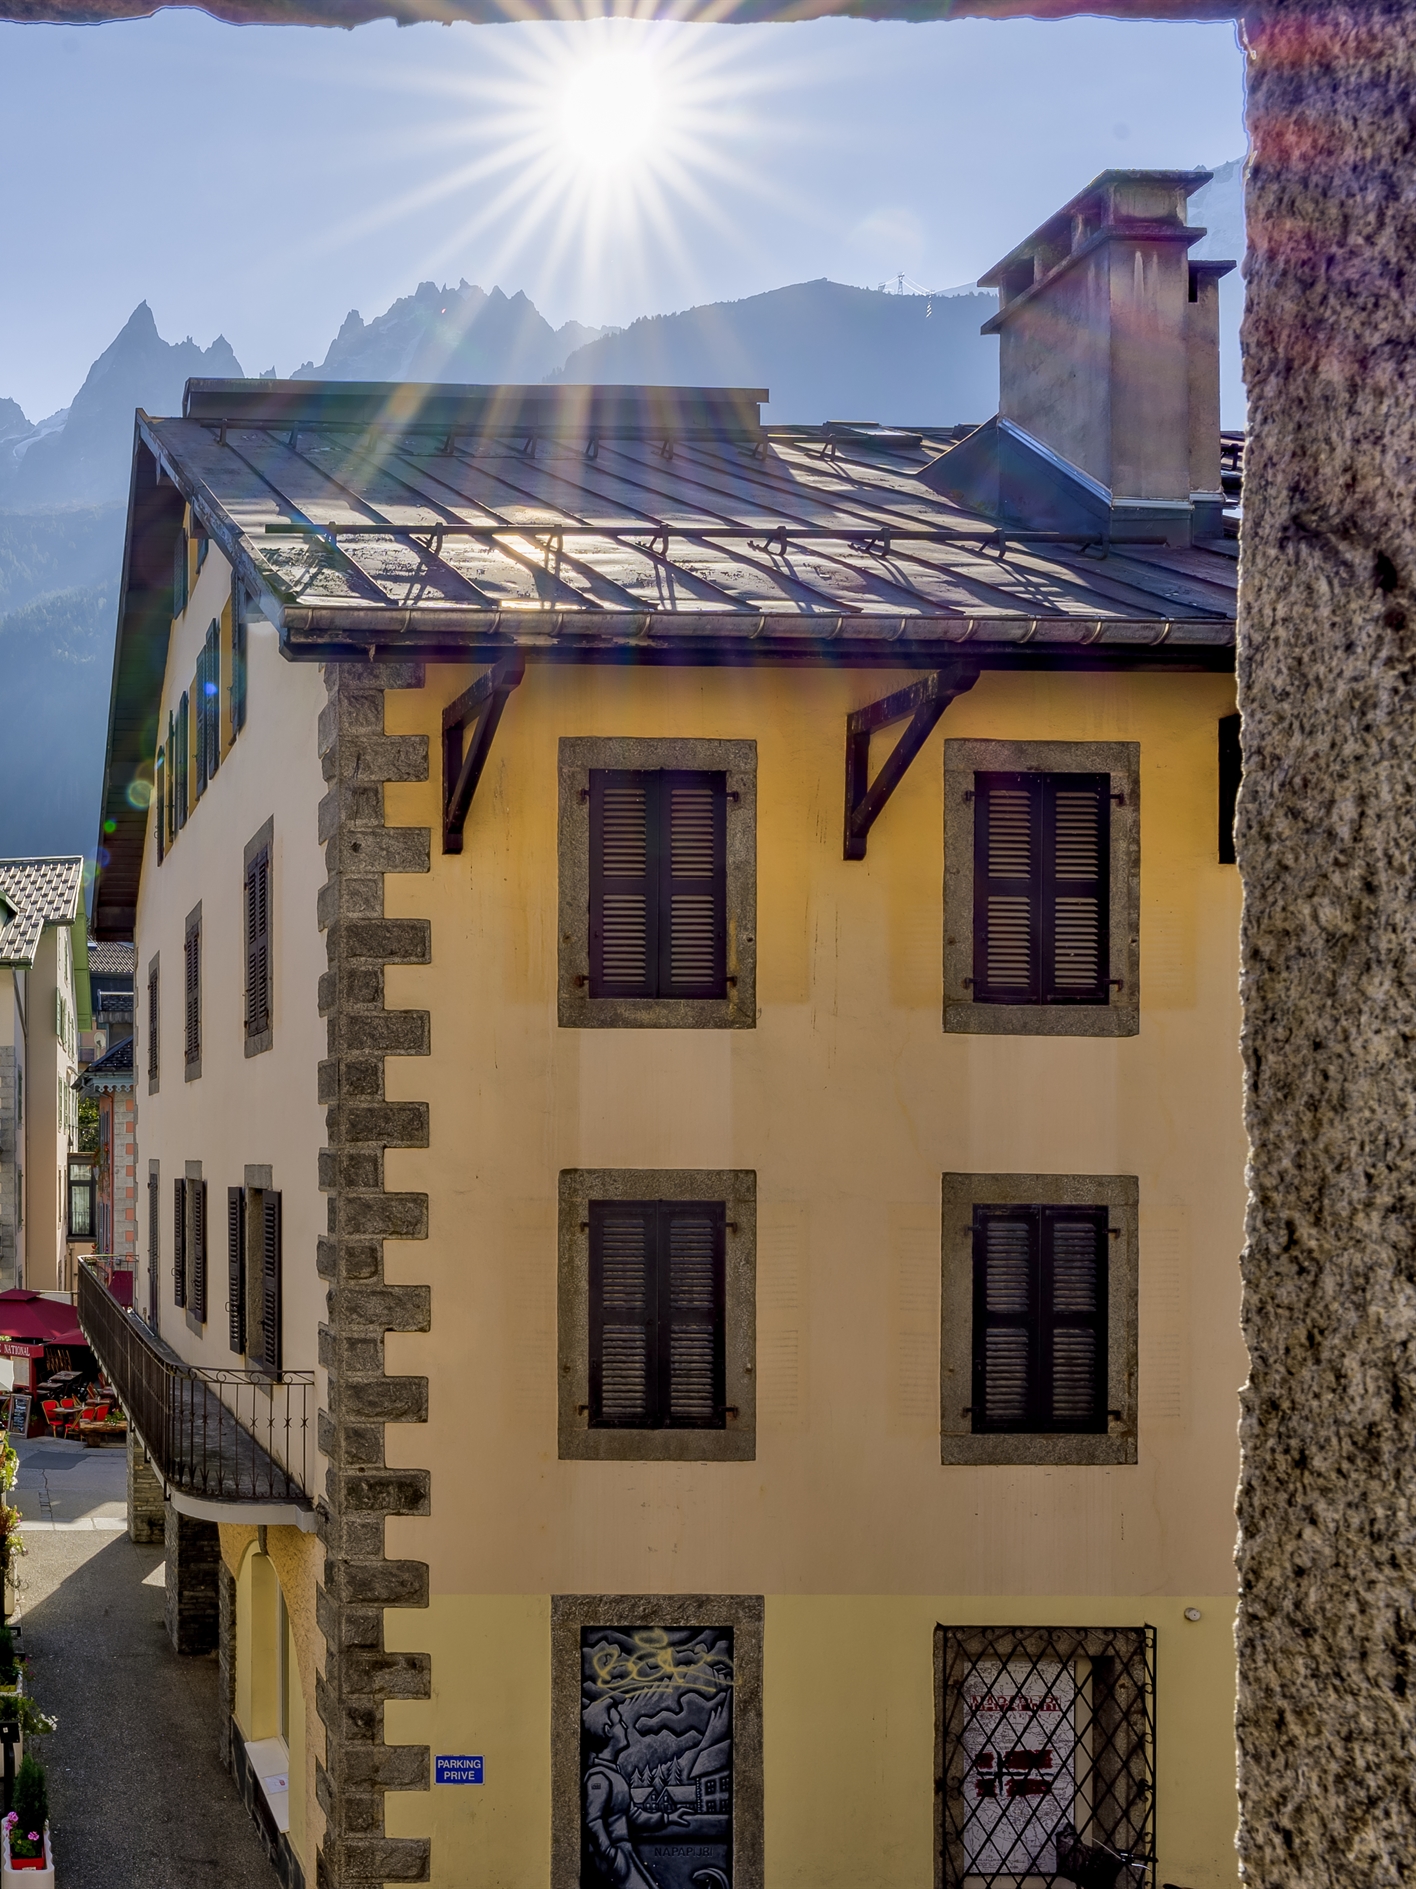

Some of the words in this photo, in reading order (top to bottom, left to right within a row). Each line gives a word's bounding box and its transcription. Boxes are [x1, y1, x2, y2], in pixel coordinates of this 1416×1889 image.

[4, 1343, 31, 1357] NATIONAL
[437, 1759, 481, 1769] PARKING
[443, 1771, 475, 1780] PRIVE
